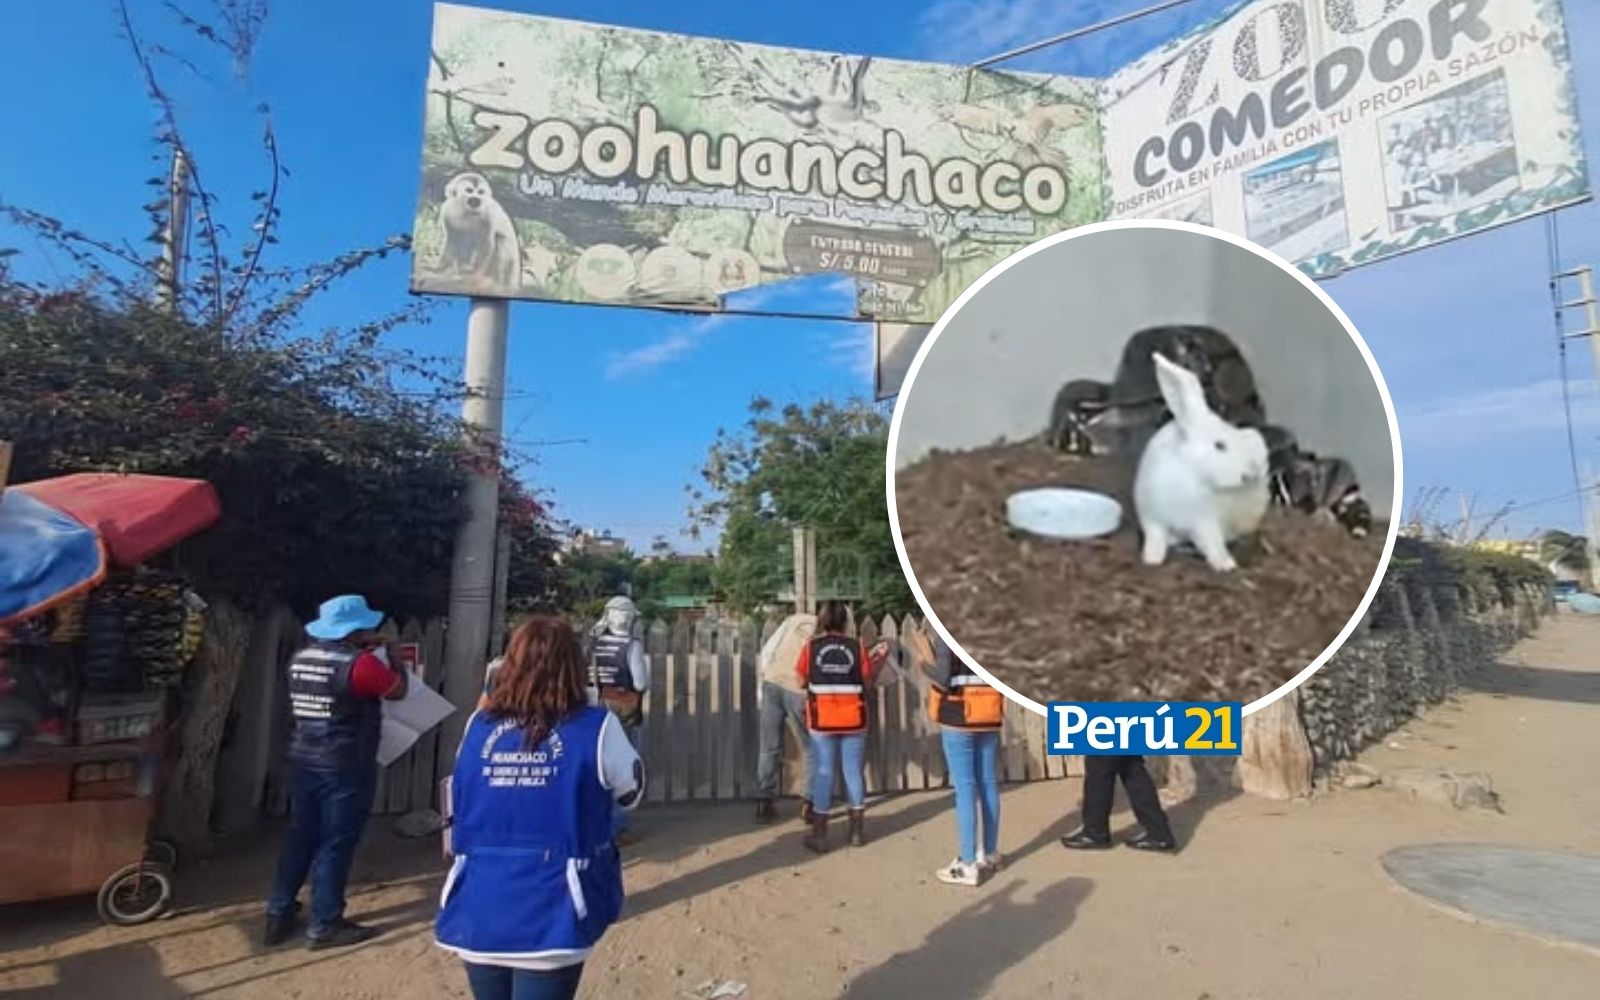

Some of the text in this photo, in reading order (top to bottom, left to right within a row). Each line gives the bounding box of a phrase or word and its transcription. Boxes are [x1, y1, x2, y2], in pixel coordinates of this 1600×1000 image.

[470, 102, 1067, 215] zoohuanchaco
[1116, 24, 1539, 216] DISFRUTA EN FAMILIA CON TU PROPIA SAZÓN
[1133, 0, 1492, 188] COMEDOR
